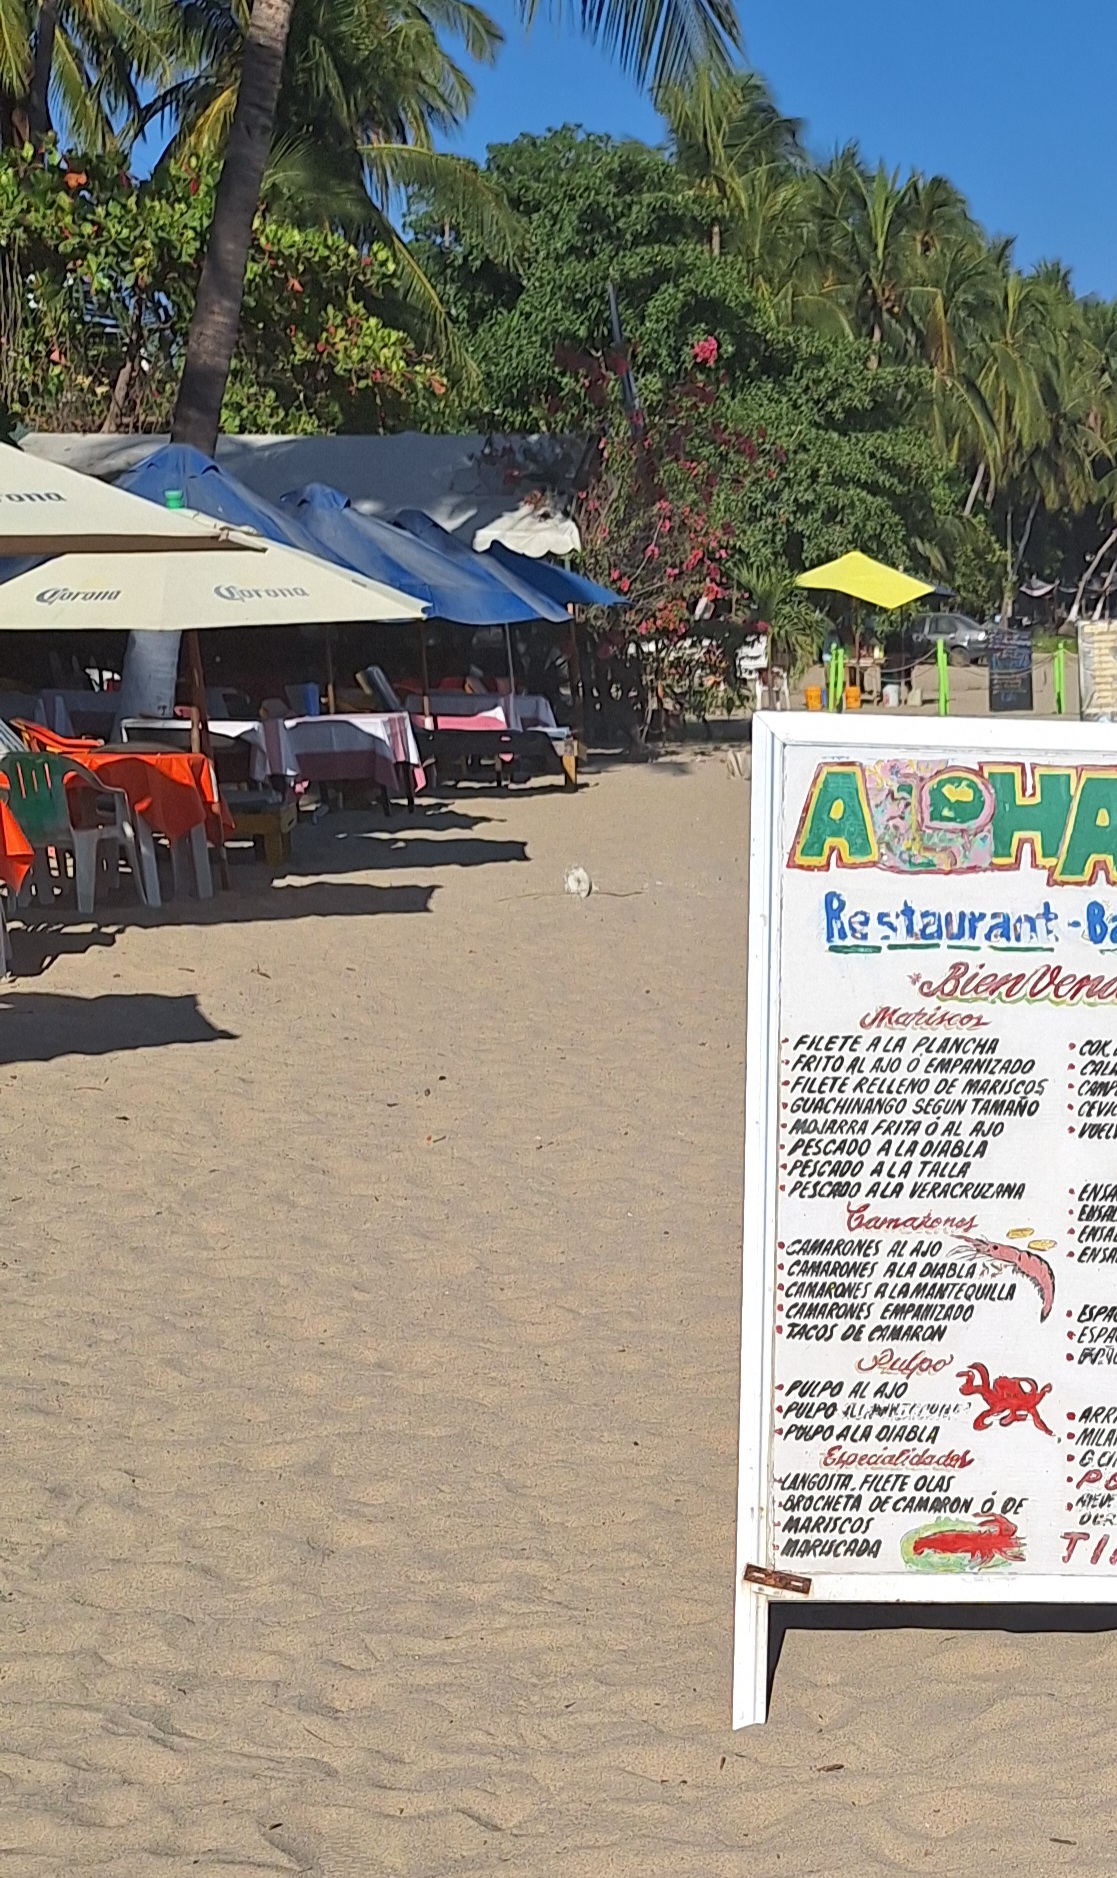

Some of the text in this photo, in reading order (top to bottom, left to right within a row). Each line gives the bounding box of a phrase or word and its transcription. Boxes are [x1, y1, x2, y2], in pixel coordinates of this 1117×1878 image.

[0, 492, 67, 503] ona
[36, 588, 122, 605] Corona
[213, 584, 309, 602] Corona
[860, 1007, 991, 1029] Mariscos
[793, 1035, 863, 1052] FILETE
[912, 1037, 1000, 1054] PLANCHA
[791, 1055, 844, 1072] FRITO
[846, 1058, 866, 1075] AL
[870, 1057, 900, 1072] AJO
[925, 1058, 1035, 1075] EMPANIZADO
[791, 1076, 1048, 1096] FILETE RELLENO DE MARISCOS
[790, 1097, 906, 1114] GUACHINANGO
[972, 1096, 1040, 1116] TAMAÑO
[789, 1119, 868, 1135] MOJARRA
[871, 1119, 920, 1136] FRITA
[941, 1121, 962, 1136] AL
[969, 1121, 1004, 1137] AJO
[788, 1139, 871, 1156] PESCADO
[920, 1140, 988, 1158] DIABLA
[788, 1159, 864, 1177] PESCADO
[918, 1161, 971, 1178] TALLA
[788, 1181, 861, 1199] PESCADO
[910, 1183, 1025, 1200] VERACRUZANA
[847, 1201, 978, 1231] Camarones
[786, 1240, 942, 1257] CAMARONES AL AJO
[787, 1262, 878, 1277] CAMARONES
[920, 1263, 977, 1279] DIABLA
[785, 1282, 869, 1299] CAMARONES
[785, 1302, 974, 1321] CAMARONES EMPANIZADO
[786, 1323, 947, 1342] TACOS DE CAMARON
[857, 1348, 954, 1379] Pulpo
[785, 1380, 908, 1399] PULPO AL AJO
[783, 1402, 837, 1419] PULPO
[783, 1424, 834, 1442] PULPO
[875, 1426, 939, 1444] DIABLA
[859, 1475, 910, 1492] FILETE
[914, 1475, 955, 1492] OLAS
[783, 1494, 862, 1512] BROCHETA
[868, 1496, 891, 1513] DE
[892, 1497, 973, 1514] CAMARON
[1001, 1498, 1029, 1515] DE
[782, 1516, 874, 1534] MARISCOS
[781, 1539, 882, 1558] MARISCADA
